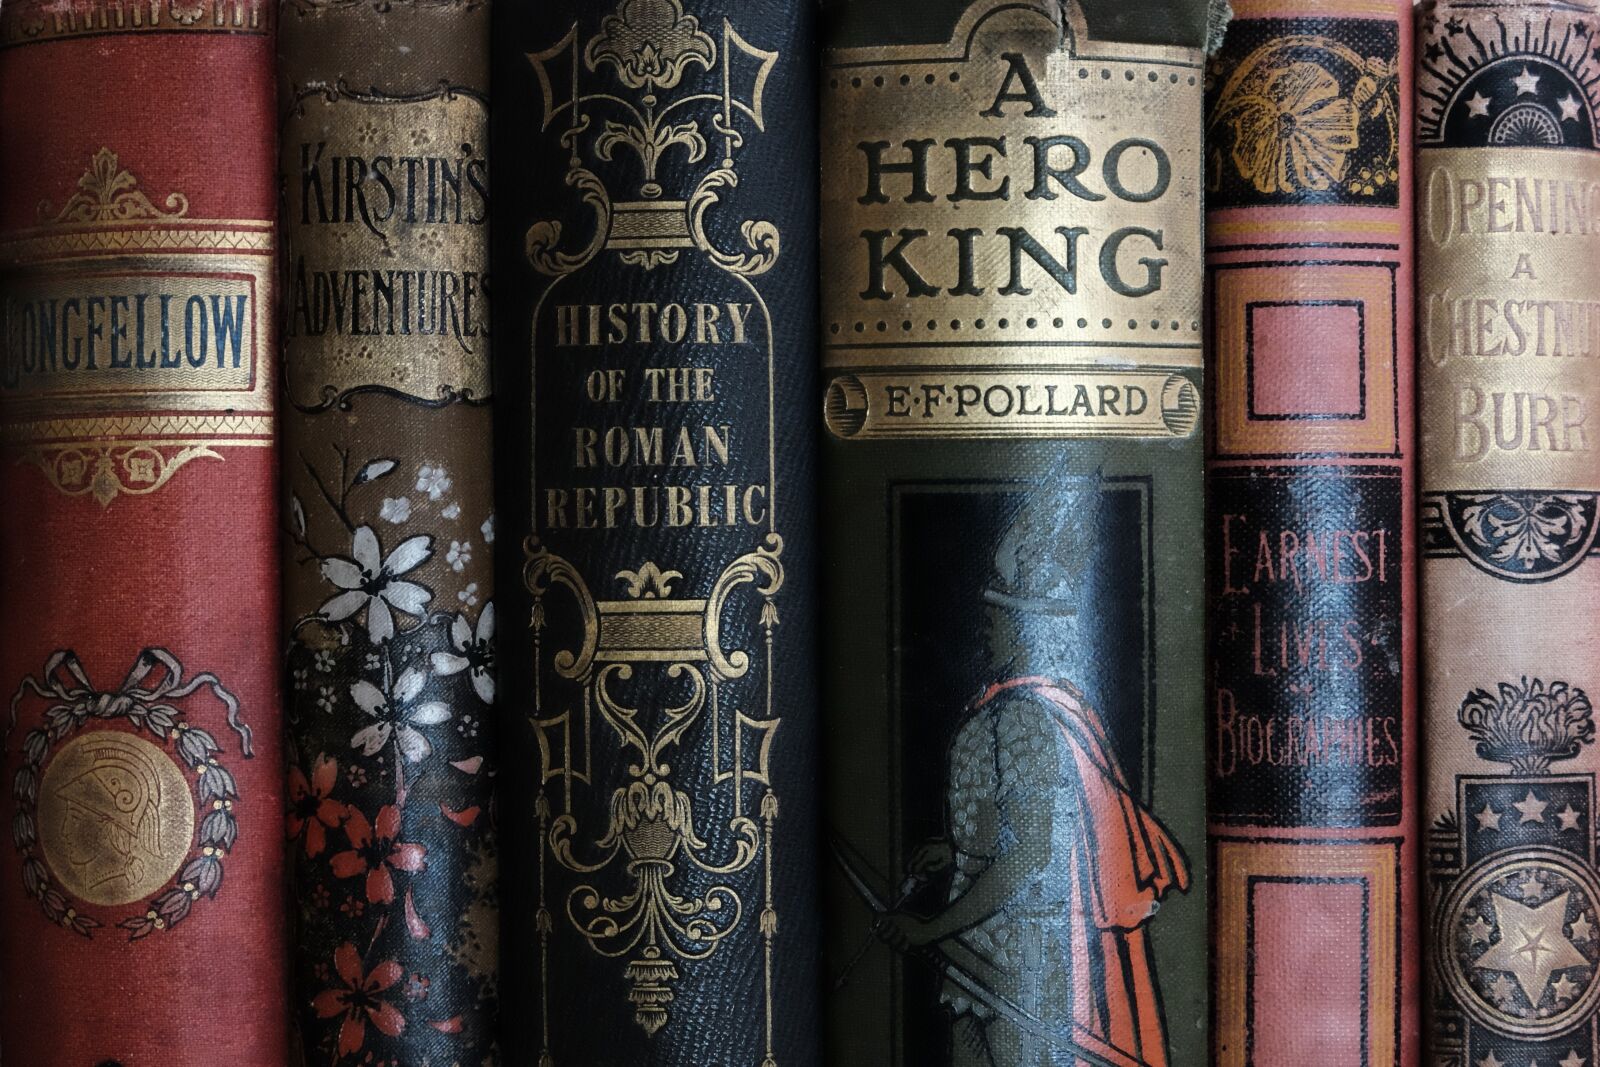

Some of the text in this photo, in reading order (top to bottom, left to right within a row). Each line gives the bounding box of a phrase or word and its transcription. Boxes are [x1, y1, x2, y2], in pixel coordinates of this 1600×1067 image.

[979, 52, 1057, 118] A
[300, 142, 490, 243] KIRSTIN'S
[856, 134, 1172, 204] HERO
[858, 226, 1169, 299] KING
[1510, 252, 1538, 280] A
[556, 303, 752, 346] HISTORY
[586, 367, 715, 402] OF THE
[573, 425, 731, 468] ROMAN
[1453, 383, 1590, 463] BURR
[545, 484, 766, 529] REPUBLIC
